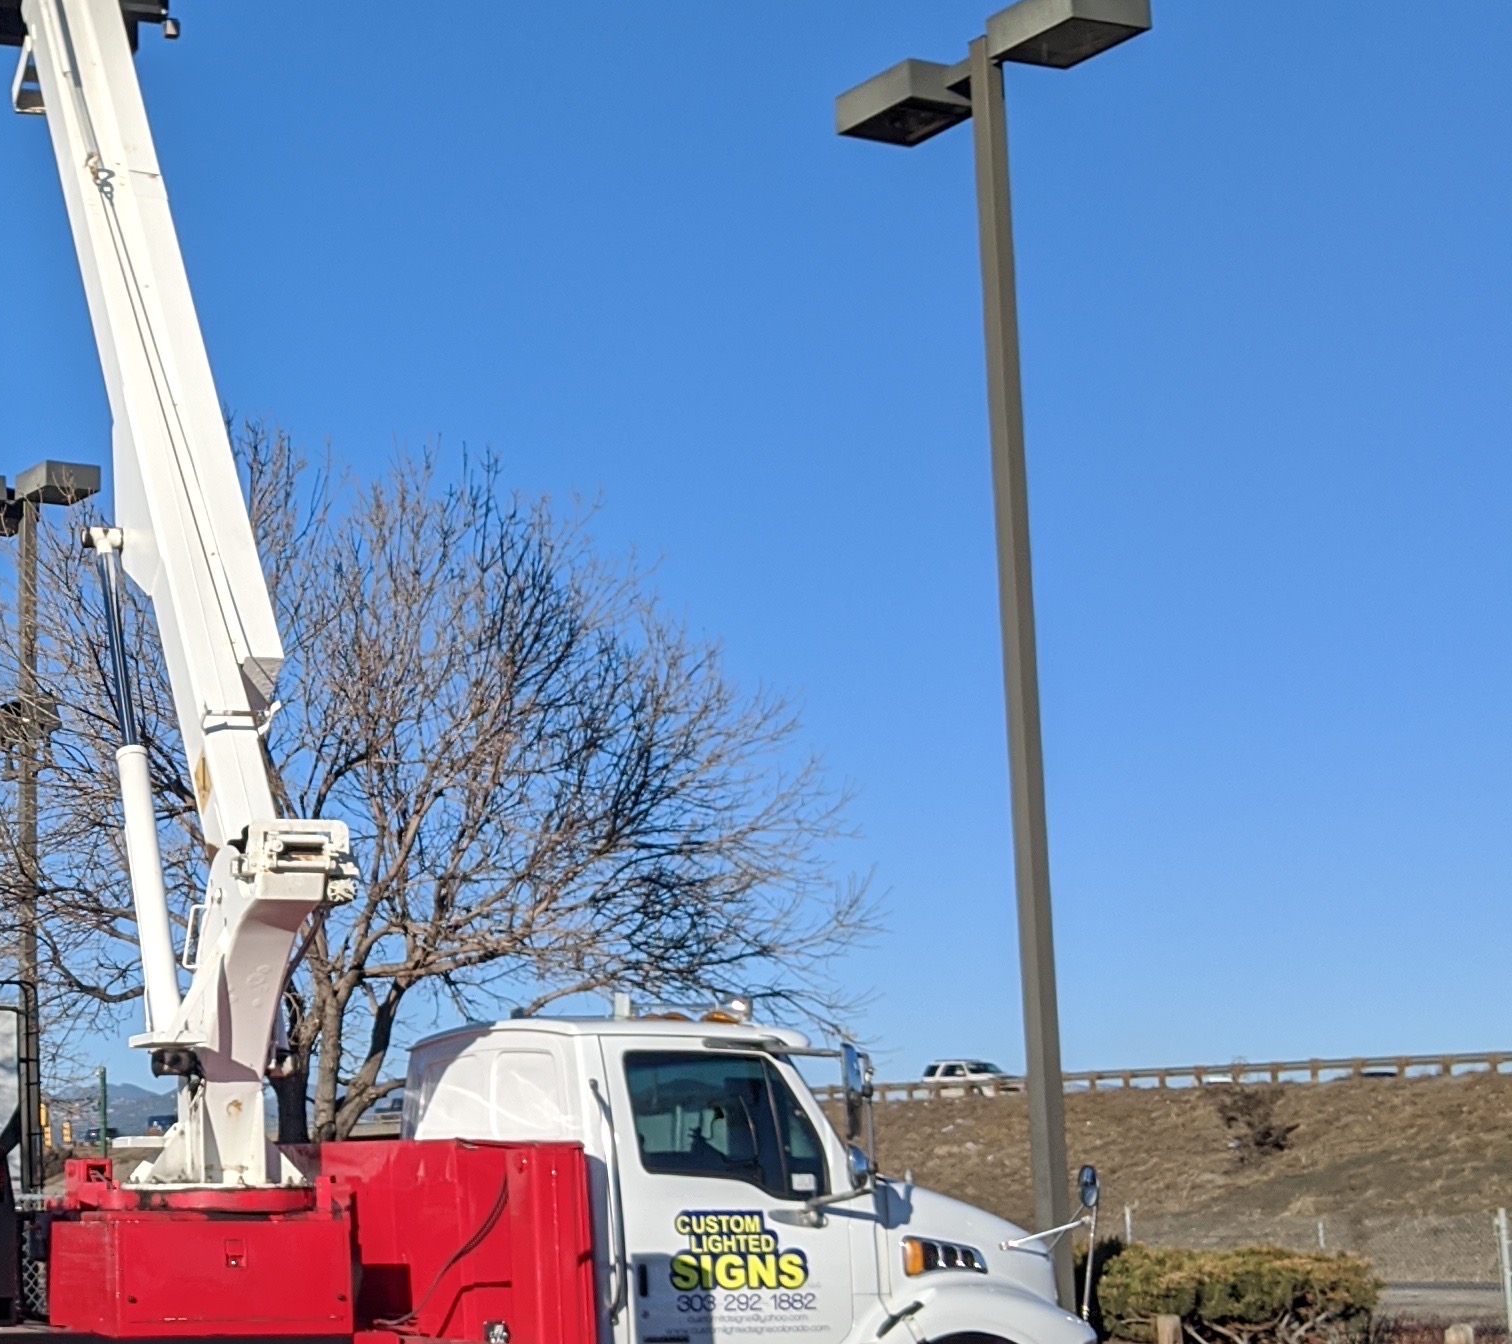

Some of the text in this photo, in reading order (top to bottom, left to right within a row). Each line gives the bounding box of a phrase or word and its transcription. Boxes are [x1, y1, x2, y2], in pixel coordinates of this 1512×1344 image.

[676, 1214, 761, 1234] CUSTOM
[690, 1234, 776, 1254] LIGHTED
[671, 1253, 806, 1290] SIGNS
